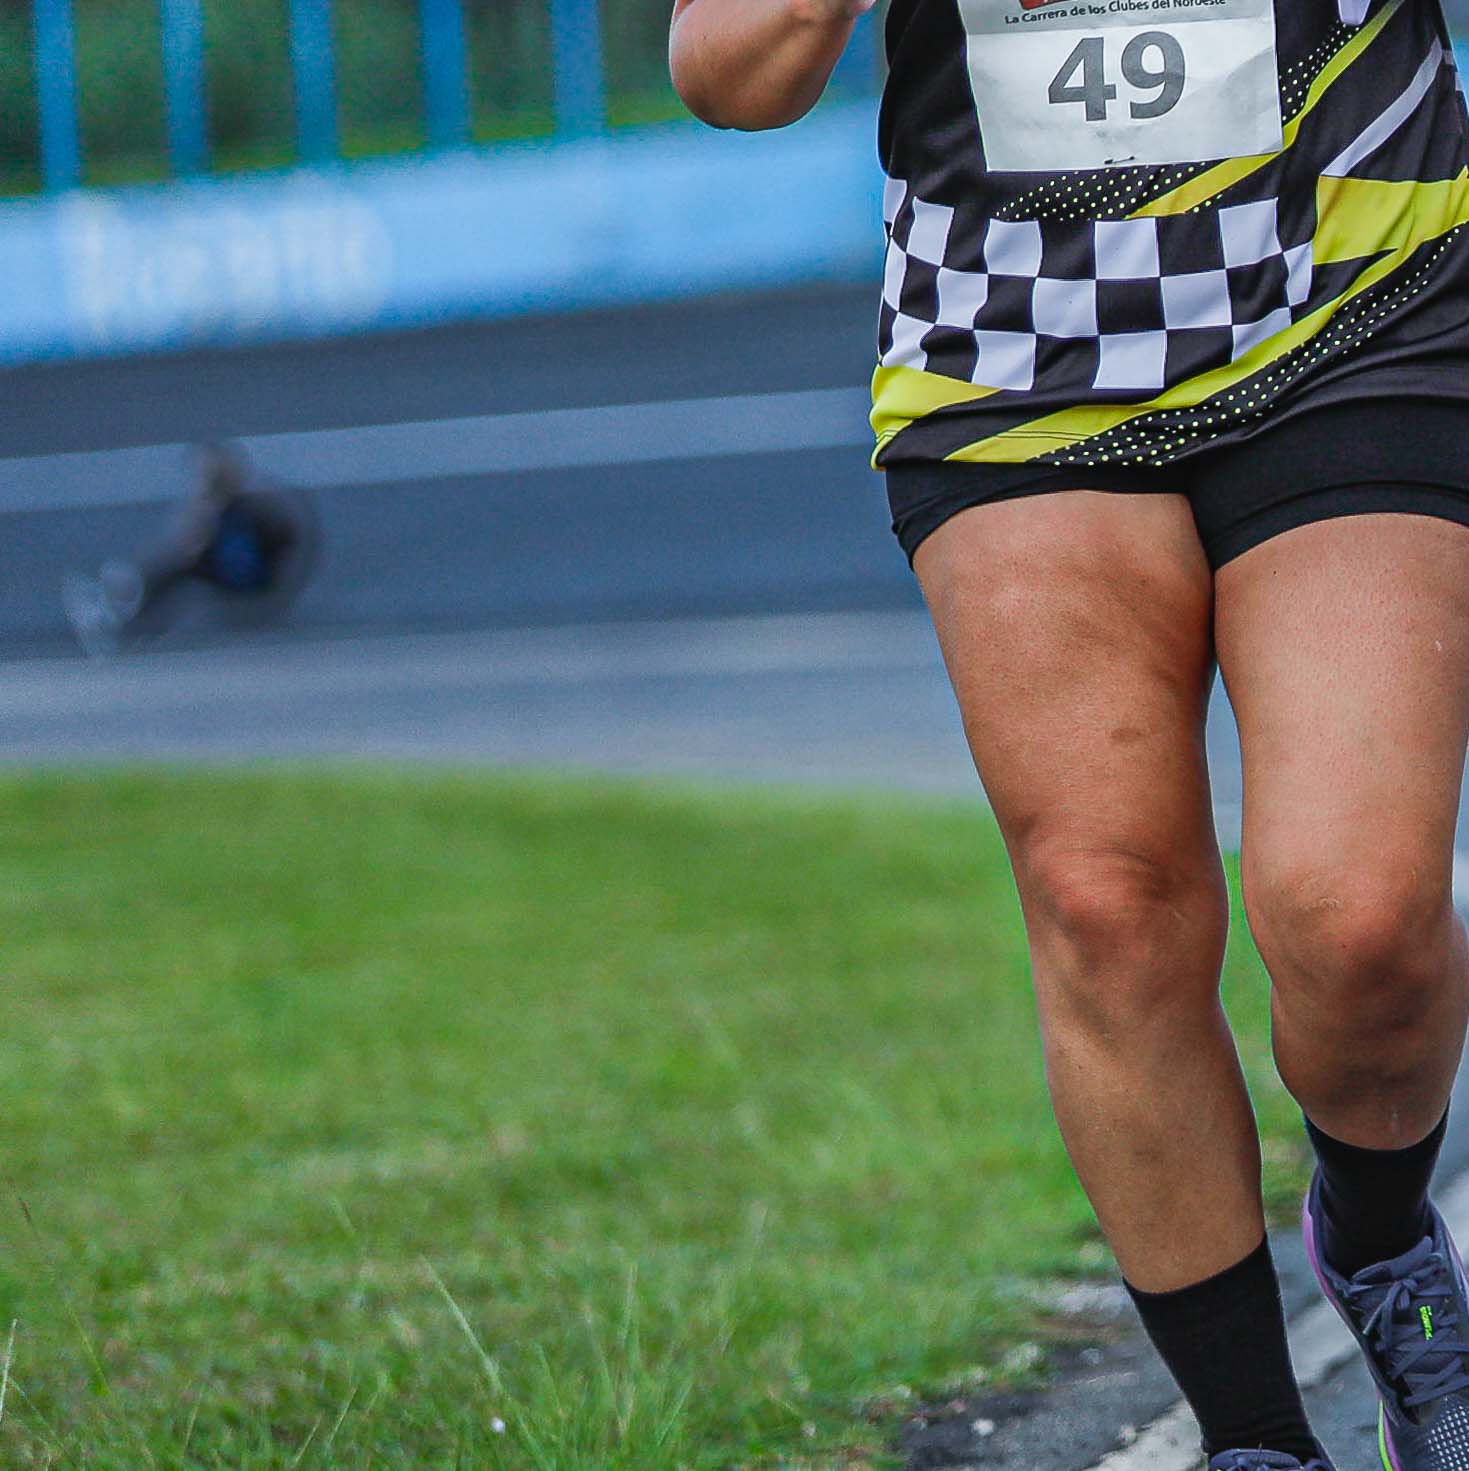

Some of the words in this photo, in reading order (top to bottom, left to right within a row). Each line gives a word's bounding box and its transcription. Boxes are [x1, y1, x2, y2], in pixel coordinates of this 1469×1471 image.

[1005, 15, 1019, 25] La
[1022, 8, 1067, 24] Carrera
[1070, 6, 1086, 17] de
[1088, 4, 1106, 15] los
[1108, 0, 1149, 13] Clubes
[1047, 31, 1187, 122] 49
